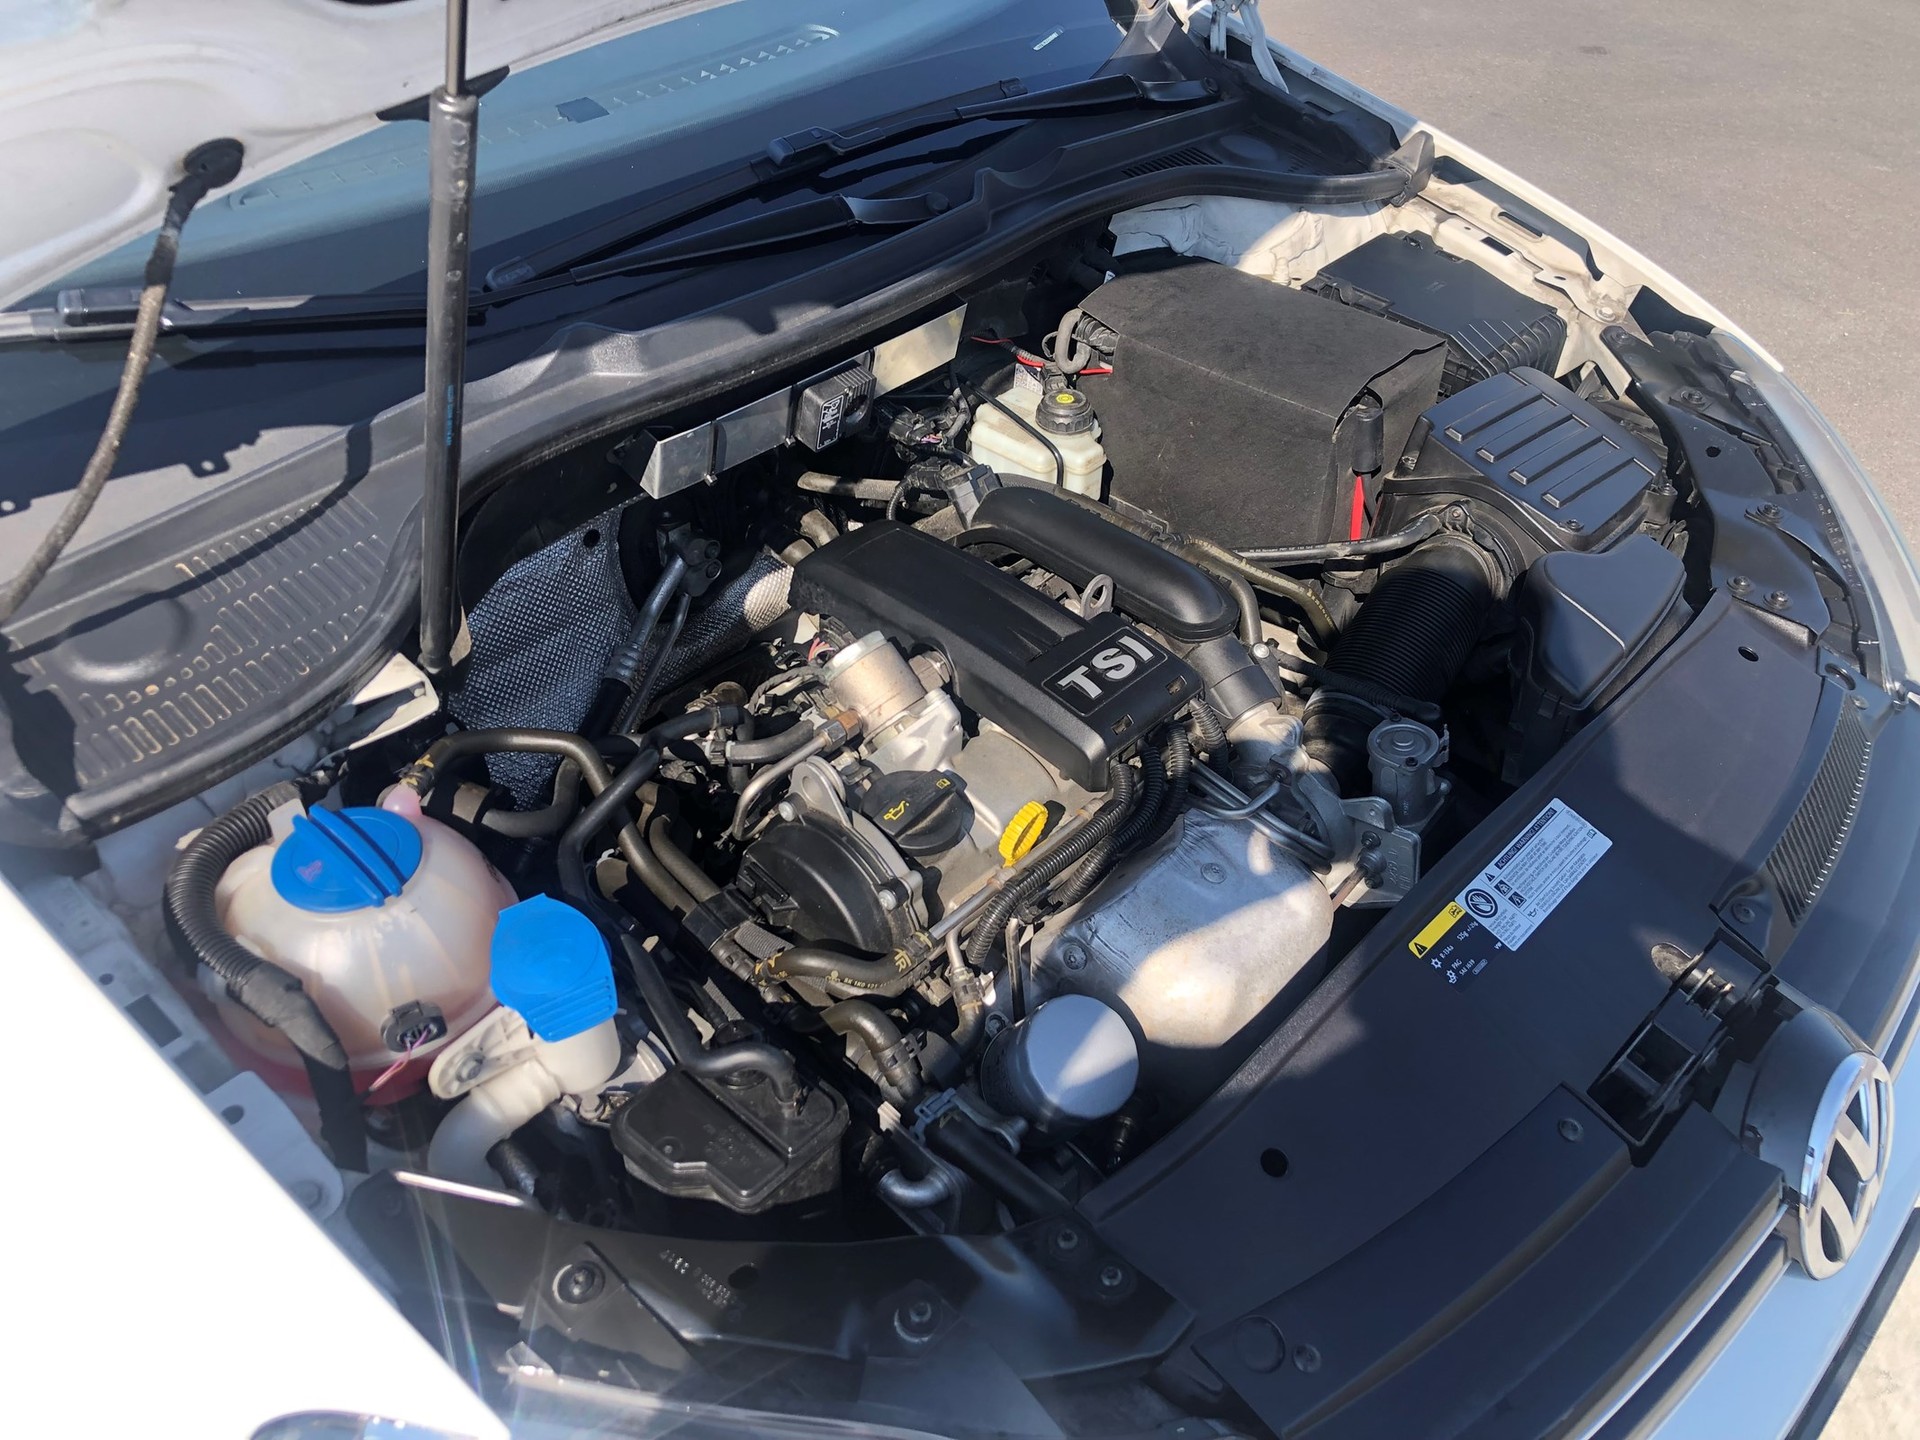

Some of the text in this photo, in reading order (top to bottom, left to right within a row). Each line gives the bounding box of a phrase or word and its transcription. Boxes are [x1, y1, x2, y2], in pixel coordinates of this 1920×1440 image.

[1057, 635, 1154, 700] TSI
[1497, 846, 1519, 868] ACHTUNG!
[1515, 828, 1537, 849] WARNING!
[1533, 808, 1556, 830] ATTENTION!
[1439, 945, 1454, 959] R-134a
[1456, 930, 1469, 941] 525g
[1451, 958, 1463, 970] PAG
[1459, 967, 1468, 976] SAE
